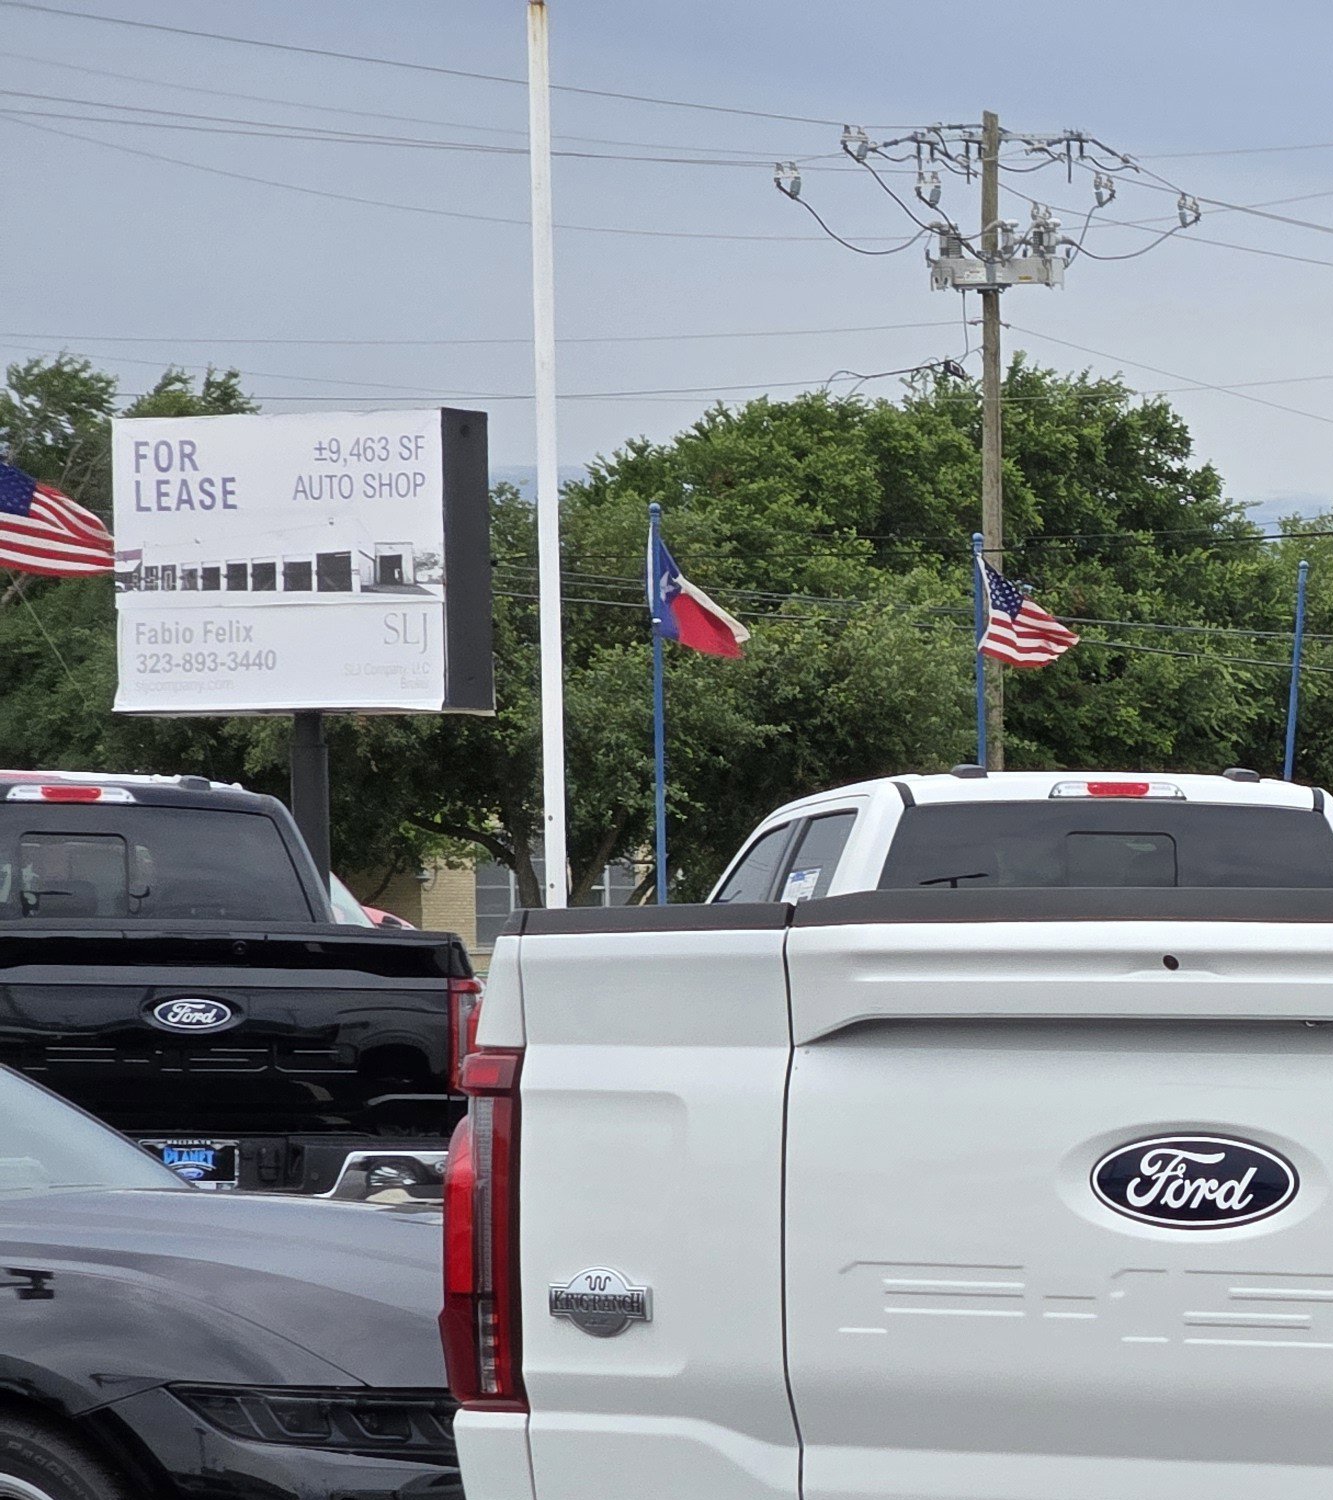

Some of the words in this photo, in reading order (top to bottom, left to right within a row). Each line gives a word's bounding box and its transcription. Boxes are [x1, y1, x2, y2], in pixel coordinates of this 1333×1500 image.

[134, 440, 199, 474] FOR
[398, 435, 425, 461] SF
[134, 477, 238, 512] LEASE
[292, 474, 354, 500] AUTO
[362, 472, 427, 499] SHOP
[135, 621, 194, 645] Fabio
[202, 620, 254, 643] Felix
[383, 612, 428, 655] SLJ
[135, 650, 277, 674] 323-893-3440
[167, 1002, 218, 1024] Ford
[1126, 1148, 1258, 1211] Ford
